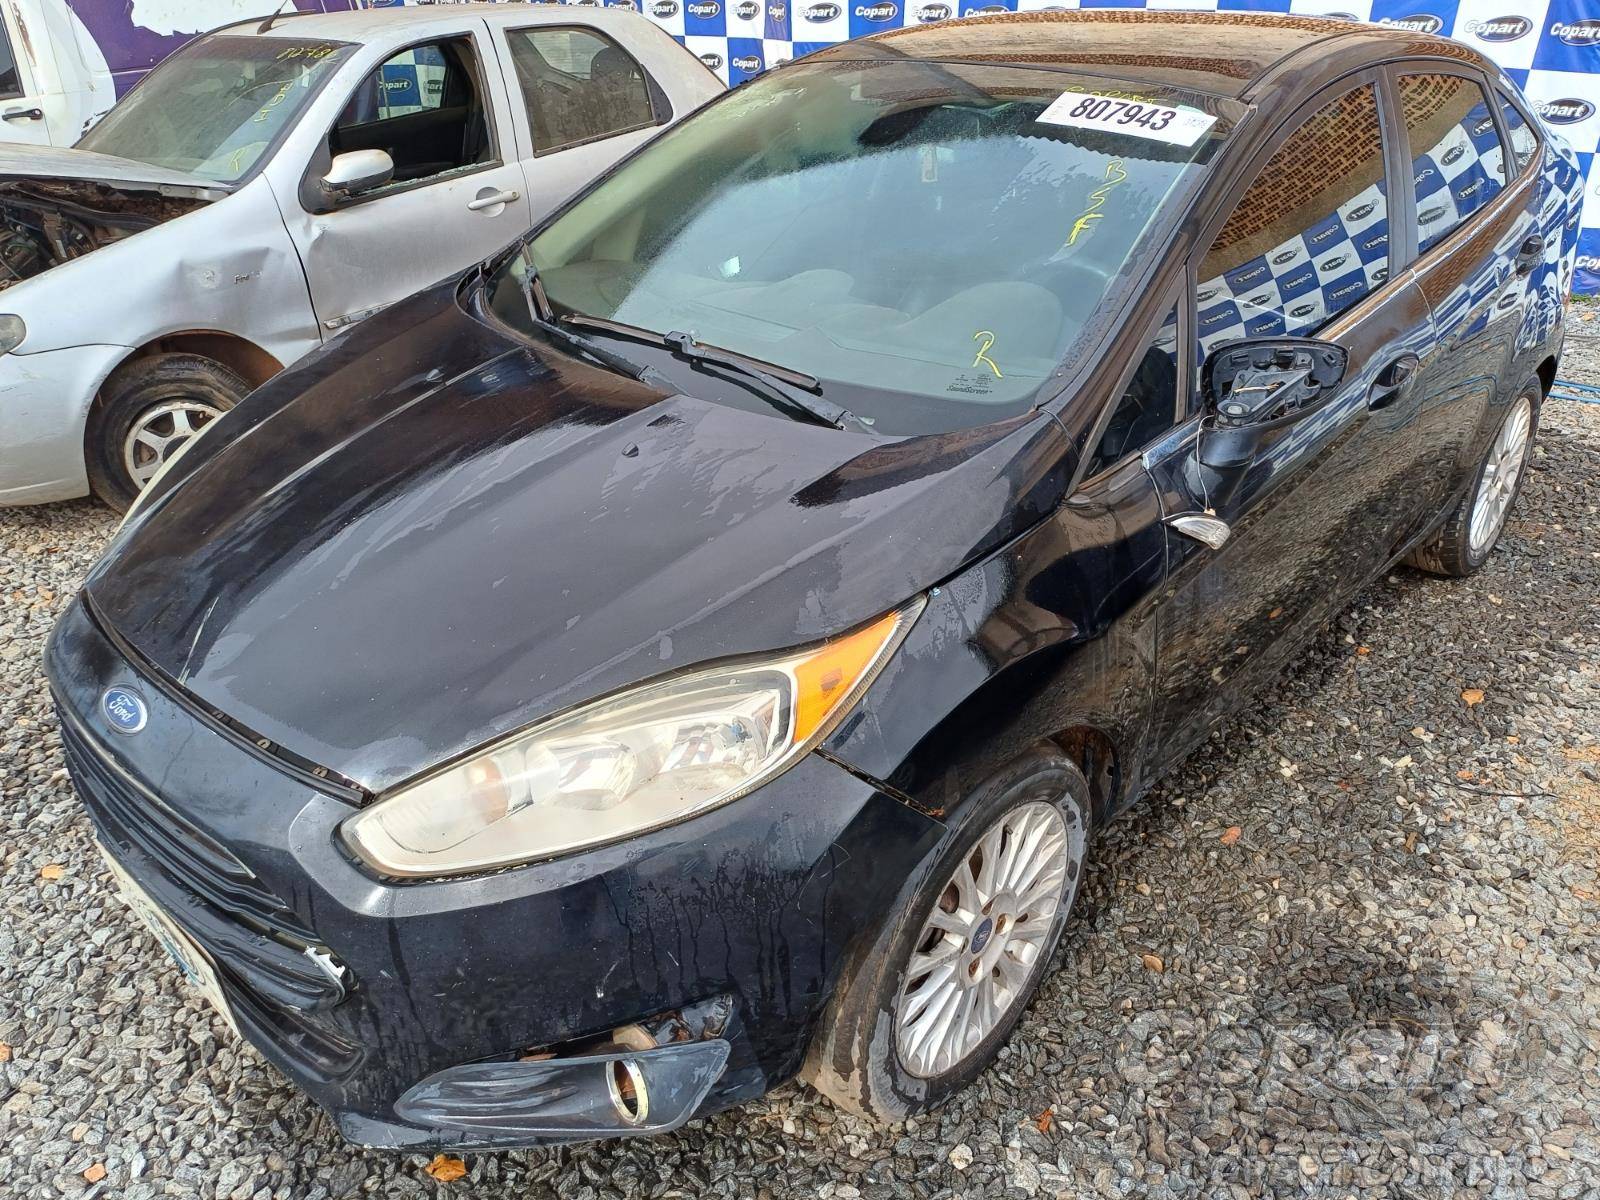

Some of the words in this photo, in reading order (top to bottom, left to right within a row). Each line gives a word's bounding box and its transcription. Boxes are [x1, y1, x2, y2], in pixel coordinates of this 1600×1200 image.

[688, 3, 716, 15] Copart
[855, 6, 894, 17] Copart
[912, 5, 946, 18] Copart
[1464, 19, 1523, 38] Copart
[732, 58, 759, 69] Copart
[1069, 97, 1177, 131] 807943
[108, 694, 136, 722] Ford
